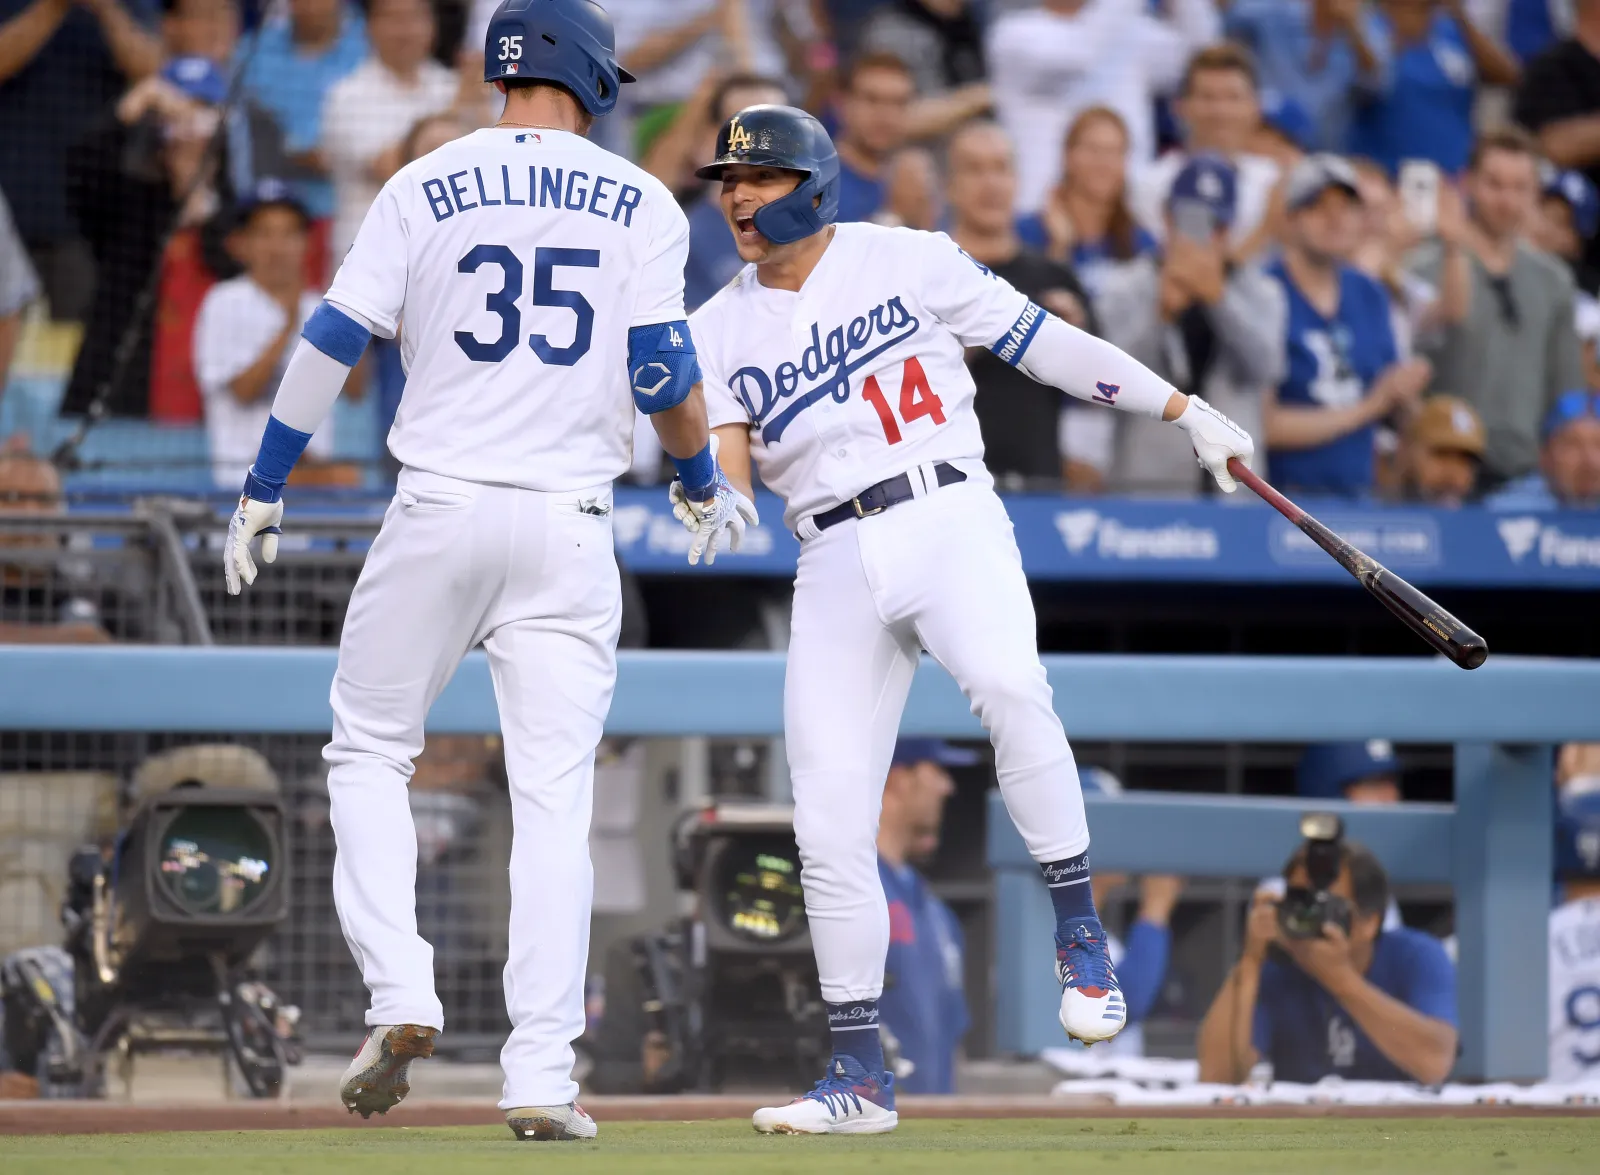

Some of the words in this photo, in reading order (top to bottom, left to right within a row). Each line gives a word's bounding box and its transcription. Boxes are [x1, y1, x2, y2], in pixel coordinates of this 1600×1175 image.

[498, 36, 523, 60] 35
[728, 116, 750, 151] LA
[422, 165, 643, 228] BELLINGER
[454, 244, 600, 366] 35
[669, 325, 684, 347] LA
[728, 296, 919, 448] Dodgers
[861, 355, 946, 445] 14
[1092, 381, 1120, 405] 14
[1043, 863, 1081, 881] Angeles
